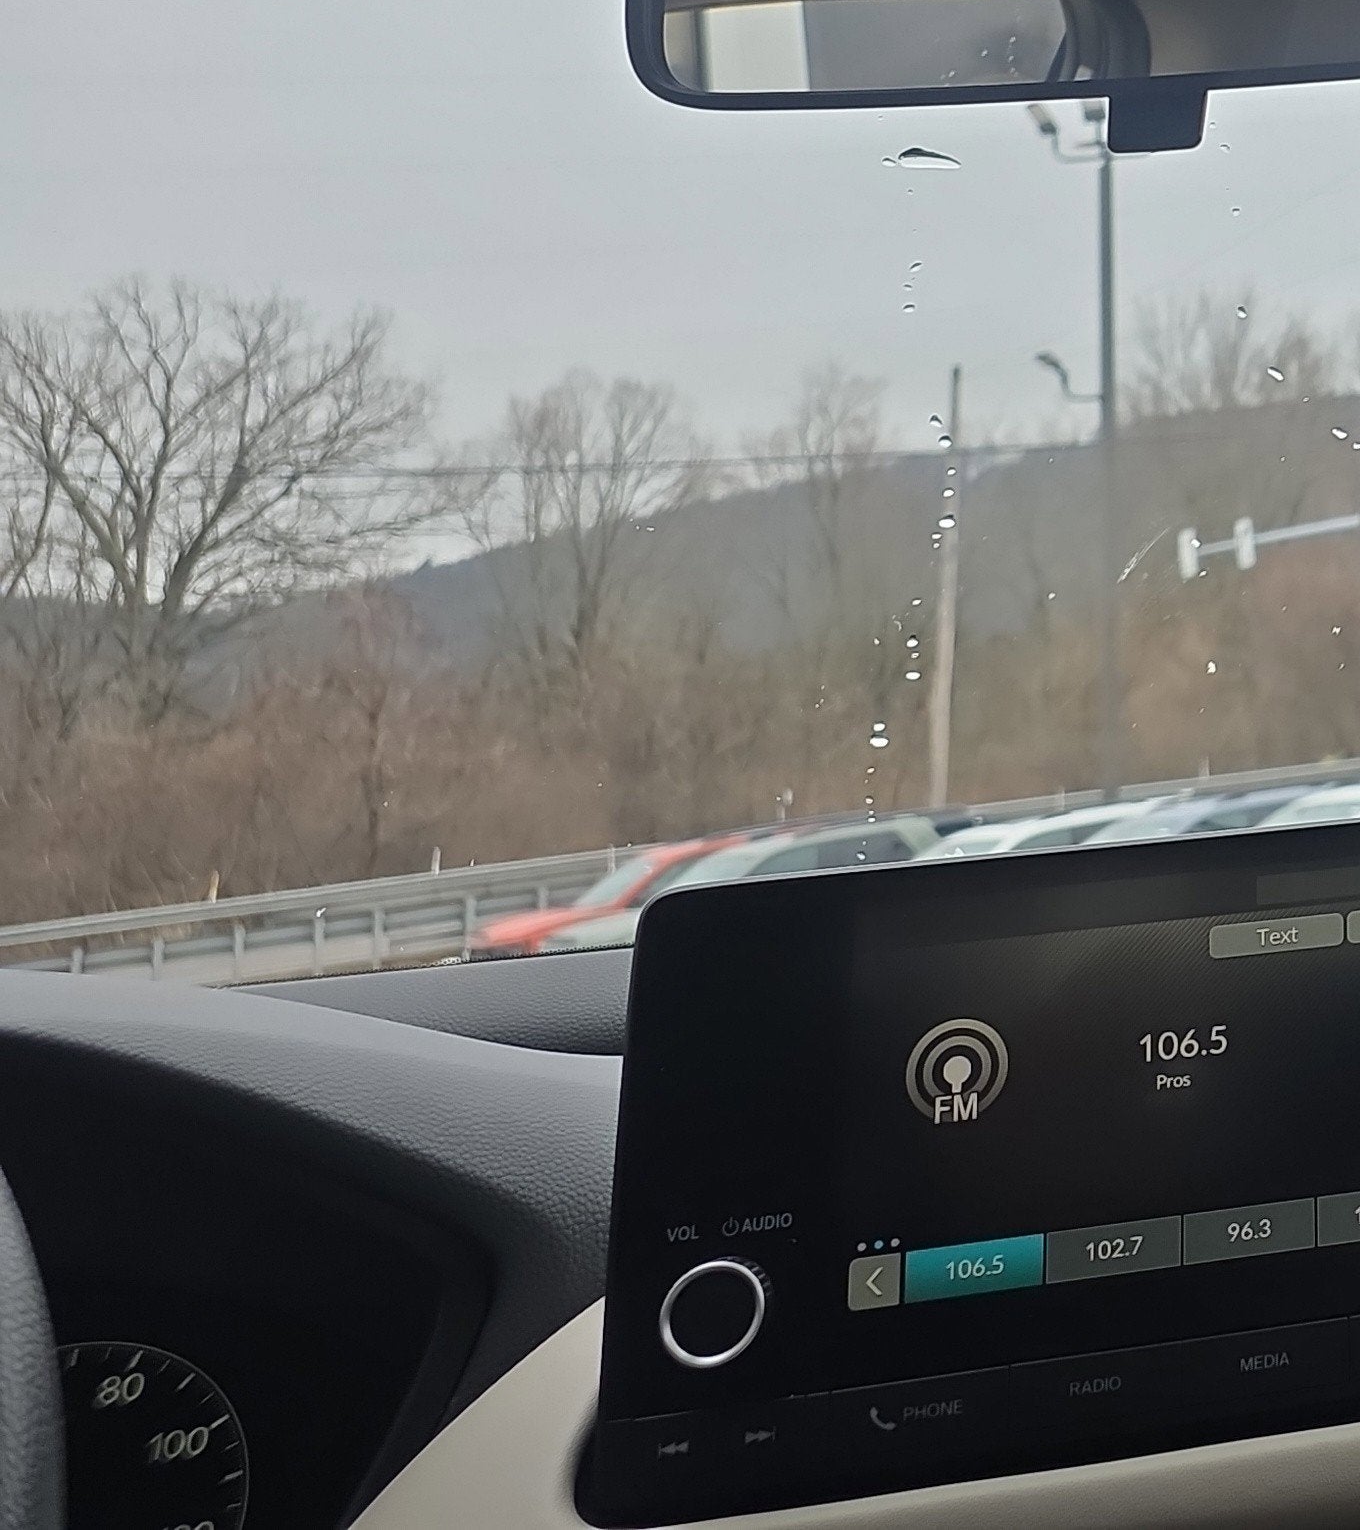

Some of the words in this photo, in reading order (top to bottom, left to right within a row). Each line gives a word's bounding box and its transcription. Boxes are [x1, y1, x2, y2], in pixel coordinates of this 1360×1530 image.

[1256, 926, 1299, 947] Text
[1139, 1024, 1229, 1063] 106.5
[1156, 1073, 1192, 1091] Pros
[933, 1091, 979, 1125] FM
[666, 1225, 700, 1243] VOL
[741, 1212, 793, 1233] AUDIO
[1227, 1218, 1272, 1243] 96.3
[1085, 1235, 1144, 1262] 102.7
[945, 1254, 1005, 1281] 106.5
[1239, 1352, 1290, 1373] MEDIA
[98, 1373, 145, 1407] 80
[1069, 1376, 1122, 1397] RADIO
[903, 1398, 964, 1421] PHONE
[148, 1426, 209, 1460] 100
